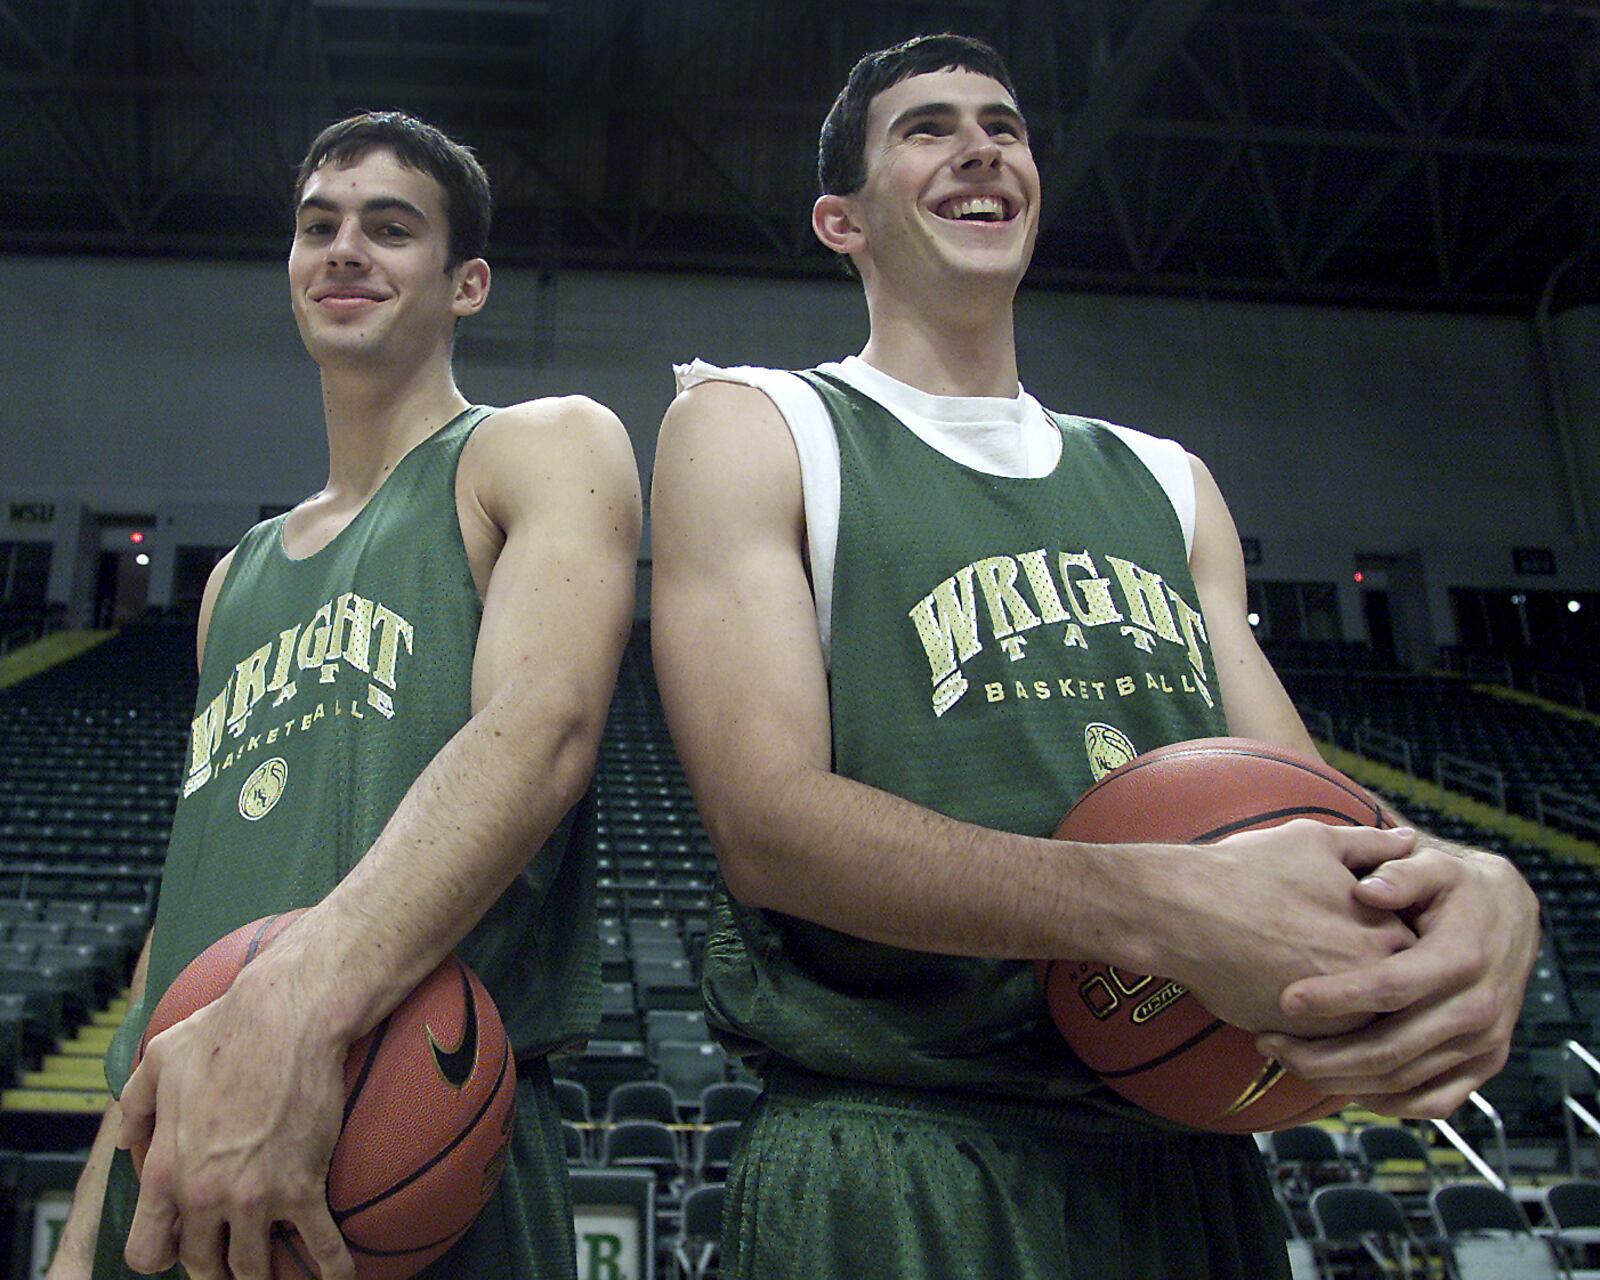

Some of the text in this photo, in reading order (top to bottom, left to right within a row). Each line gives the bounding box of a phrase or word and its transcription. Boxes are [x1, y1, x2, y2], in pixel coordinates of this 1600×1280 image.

[189, 592, 413, 776] WRIGHT
[909, 549, 1208, 687] WRIGHT
[984, 671, 1196, 703] BASKETBALL
